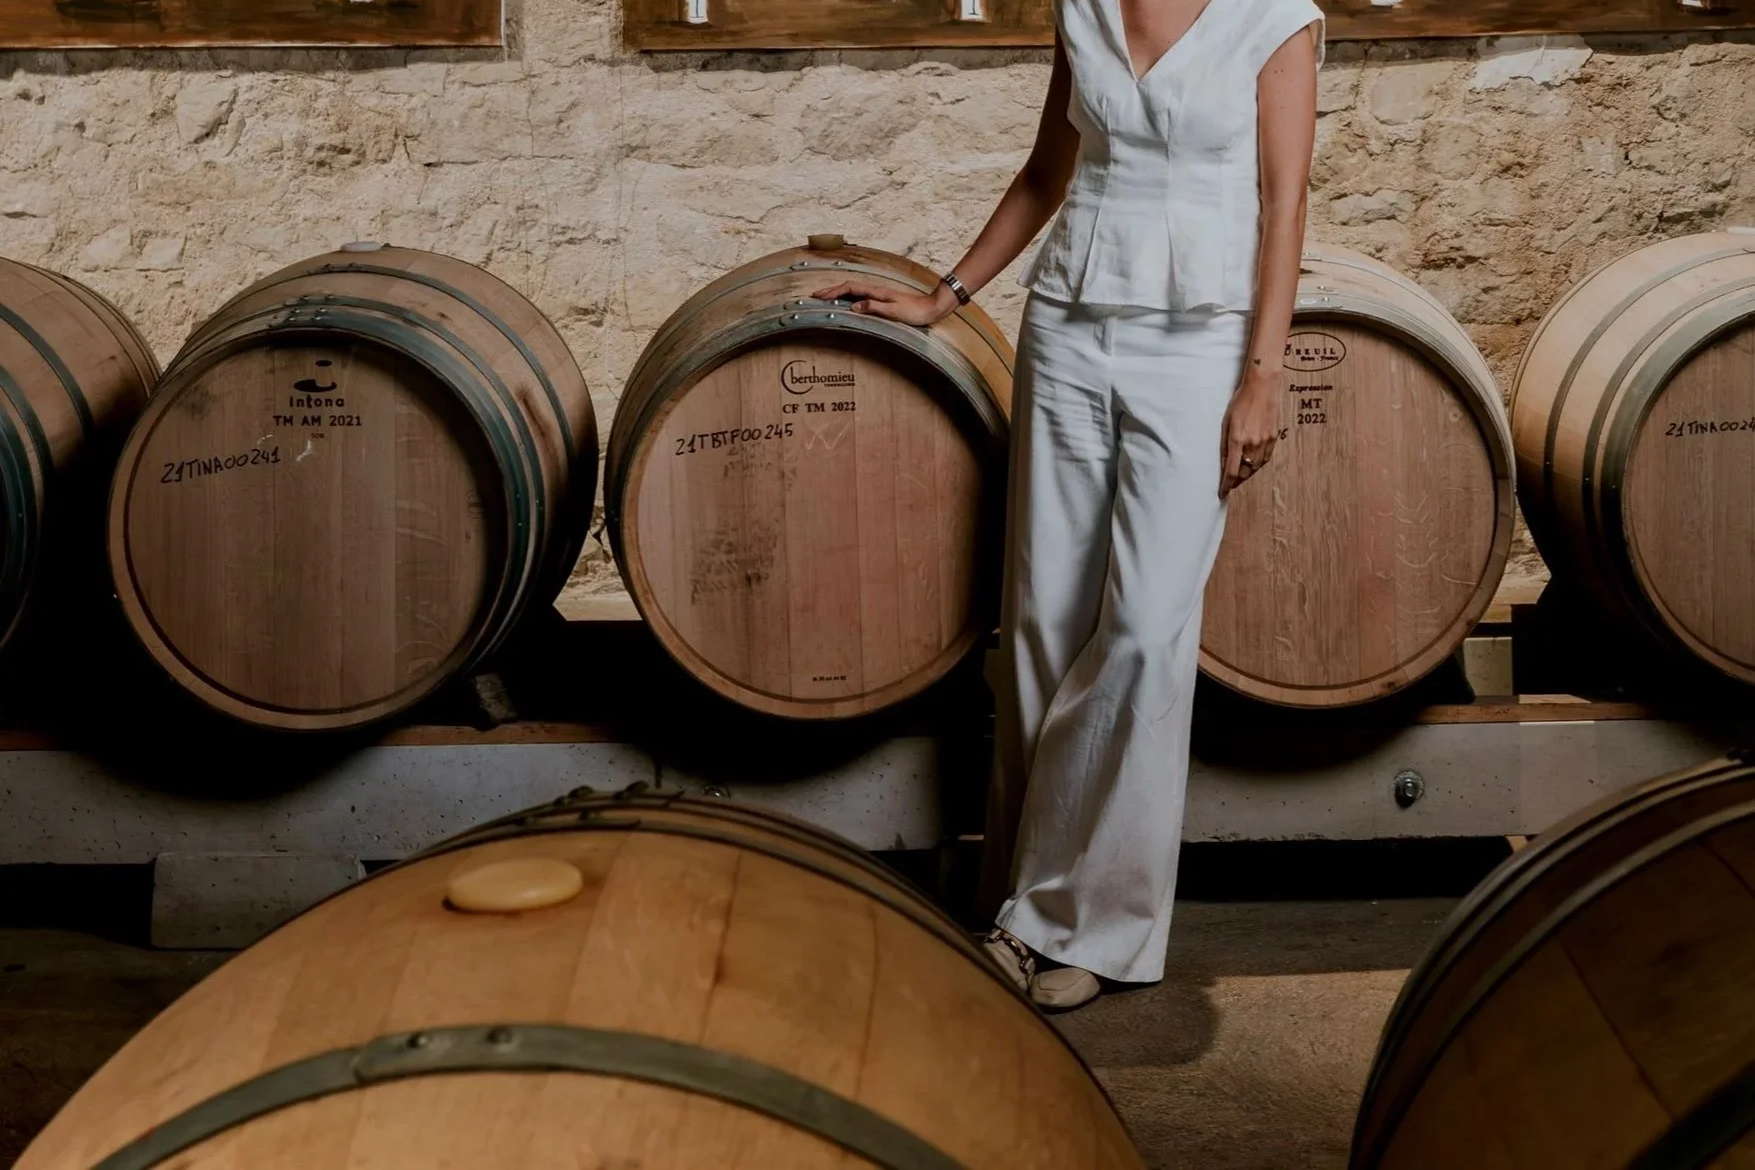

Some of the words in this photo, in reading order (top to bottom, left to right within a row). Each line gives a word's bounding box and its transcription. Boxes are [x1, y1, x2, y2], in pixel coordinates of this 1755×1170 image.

[289, 395, 346, 409] Intona
[782, 403, 800, 414] CF
[805, 402, 826, 413] TM
[831, 401, 857, 412] 2022
[1301, 398, 1323, 410] MT
[273, 415, 294, 427] TM
[301, 415, 322, 427] AM
[329, 415, 362, 427] 2021
[1297, 413, 1327, 425] 2022
